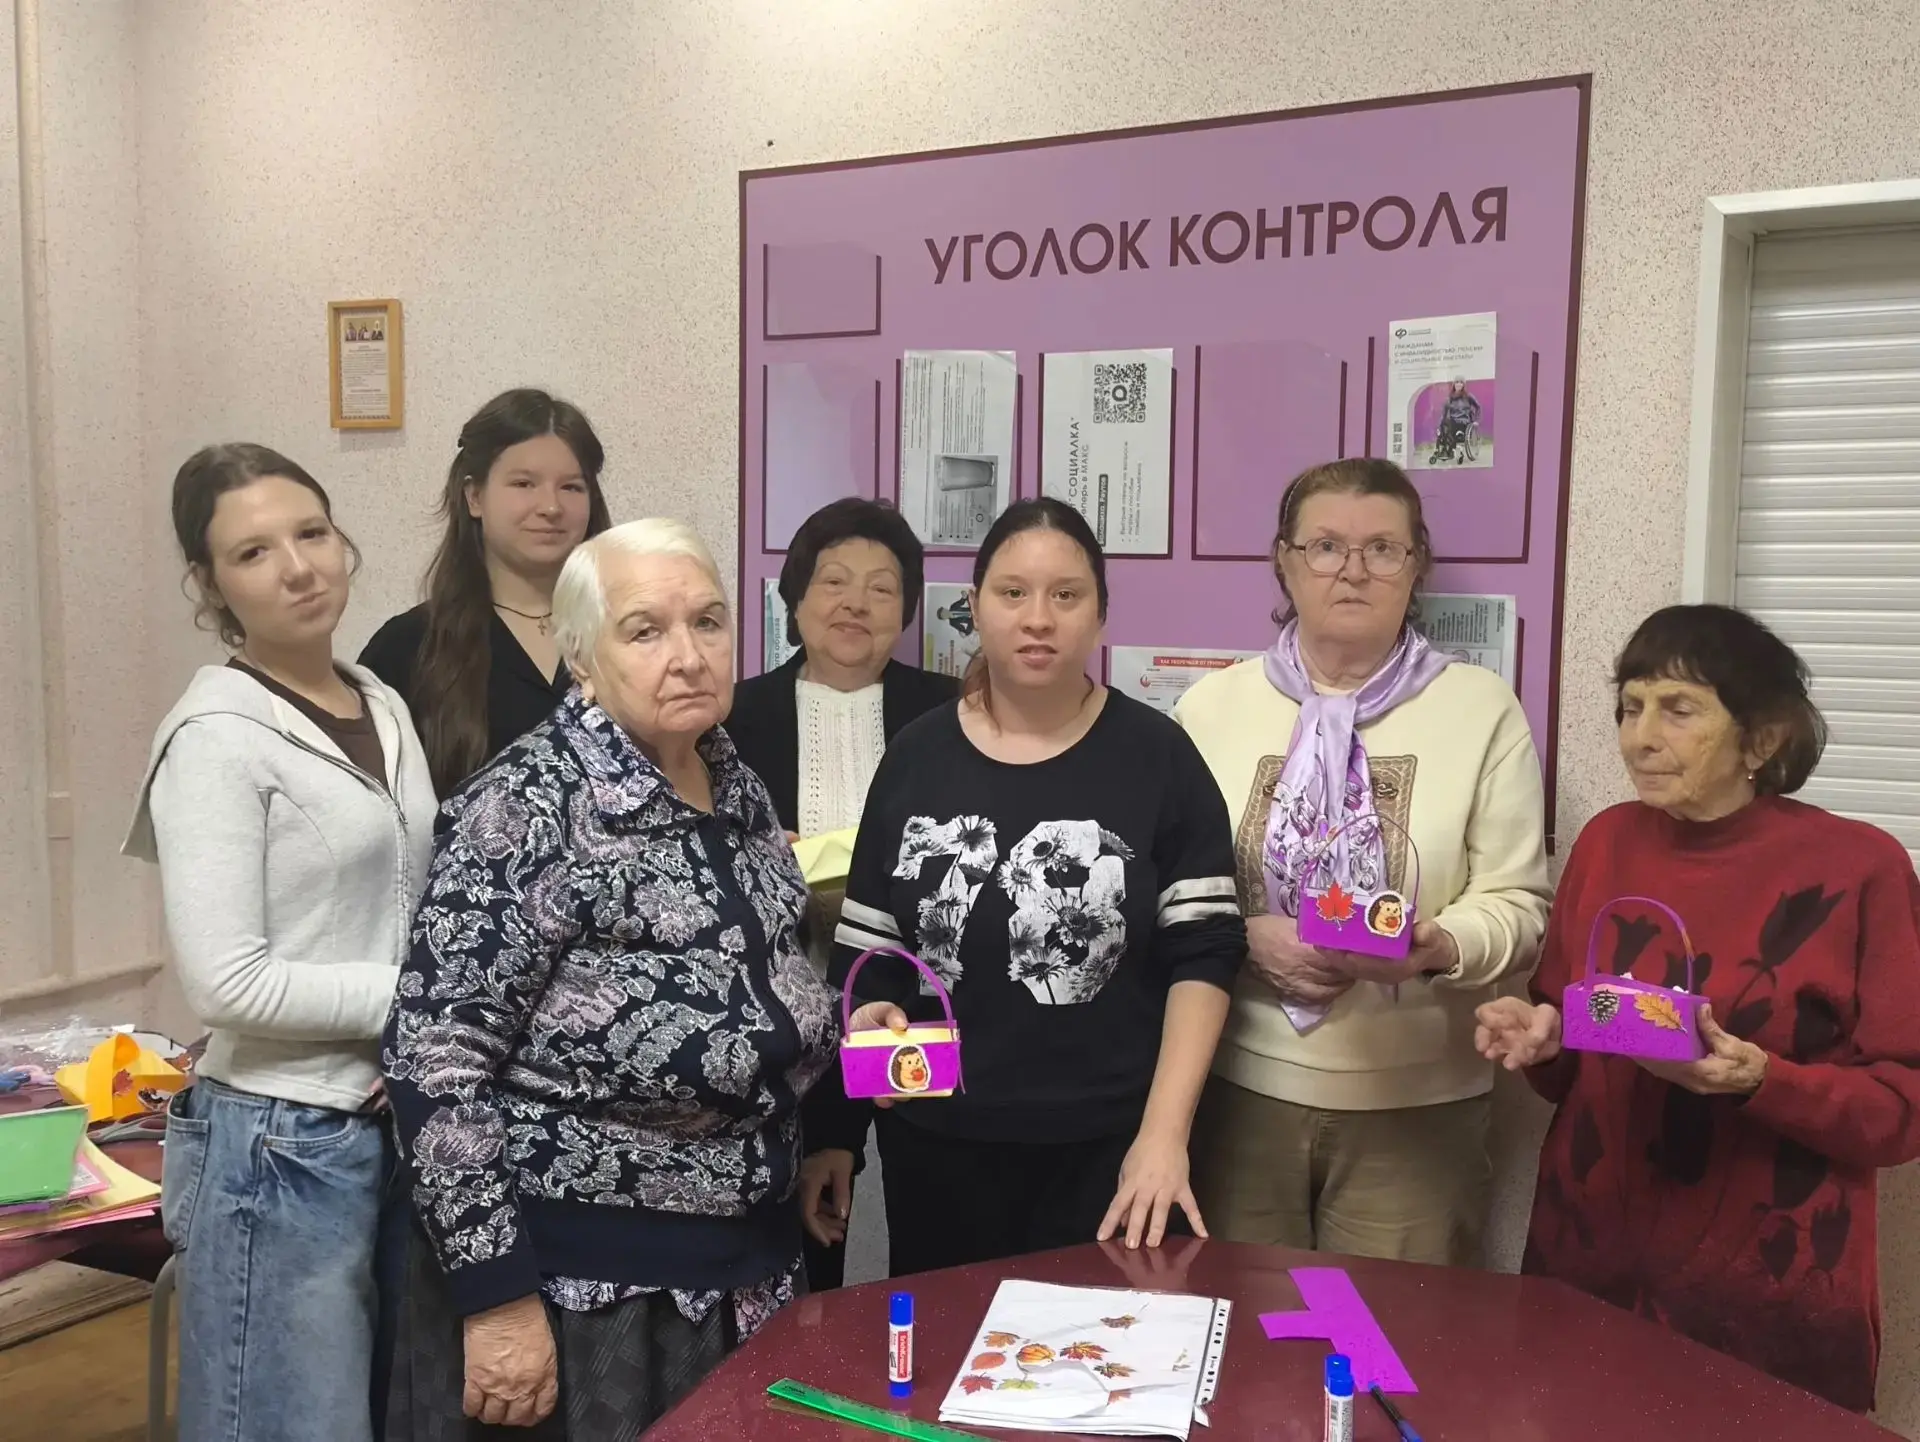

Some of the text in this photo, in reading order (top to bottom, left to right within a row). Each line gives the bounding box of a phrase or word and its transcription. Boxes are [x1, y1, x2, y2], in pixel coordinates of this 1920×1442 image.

[924, 186, 1509, 285] УГОЛОК КОНТРОЛЯ
[1068, 417, 1080, 502] "СОЦИАЛКА"
[1081, 444, 1090, 474] МАКС
[892, 814, 1135, 1006] 78
